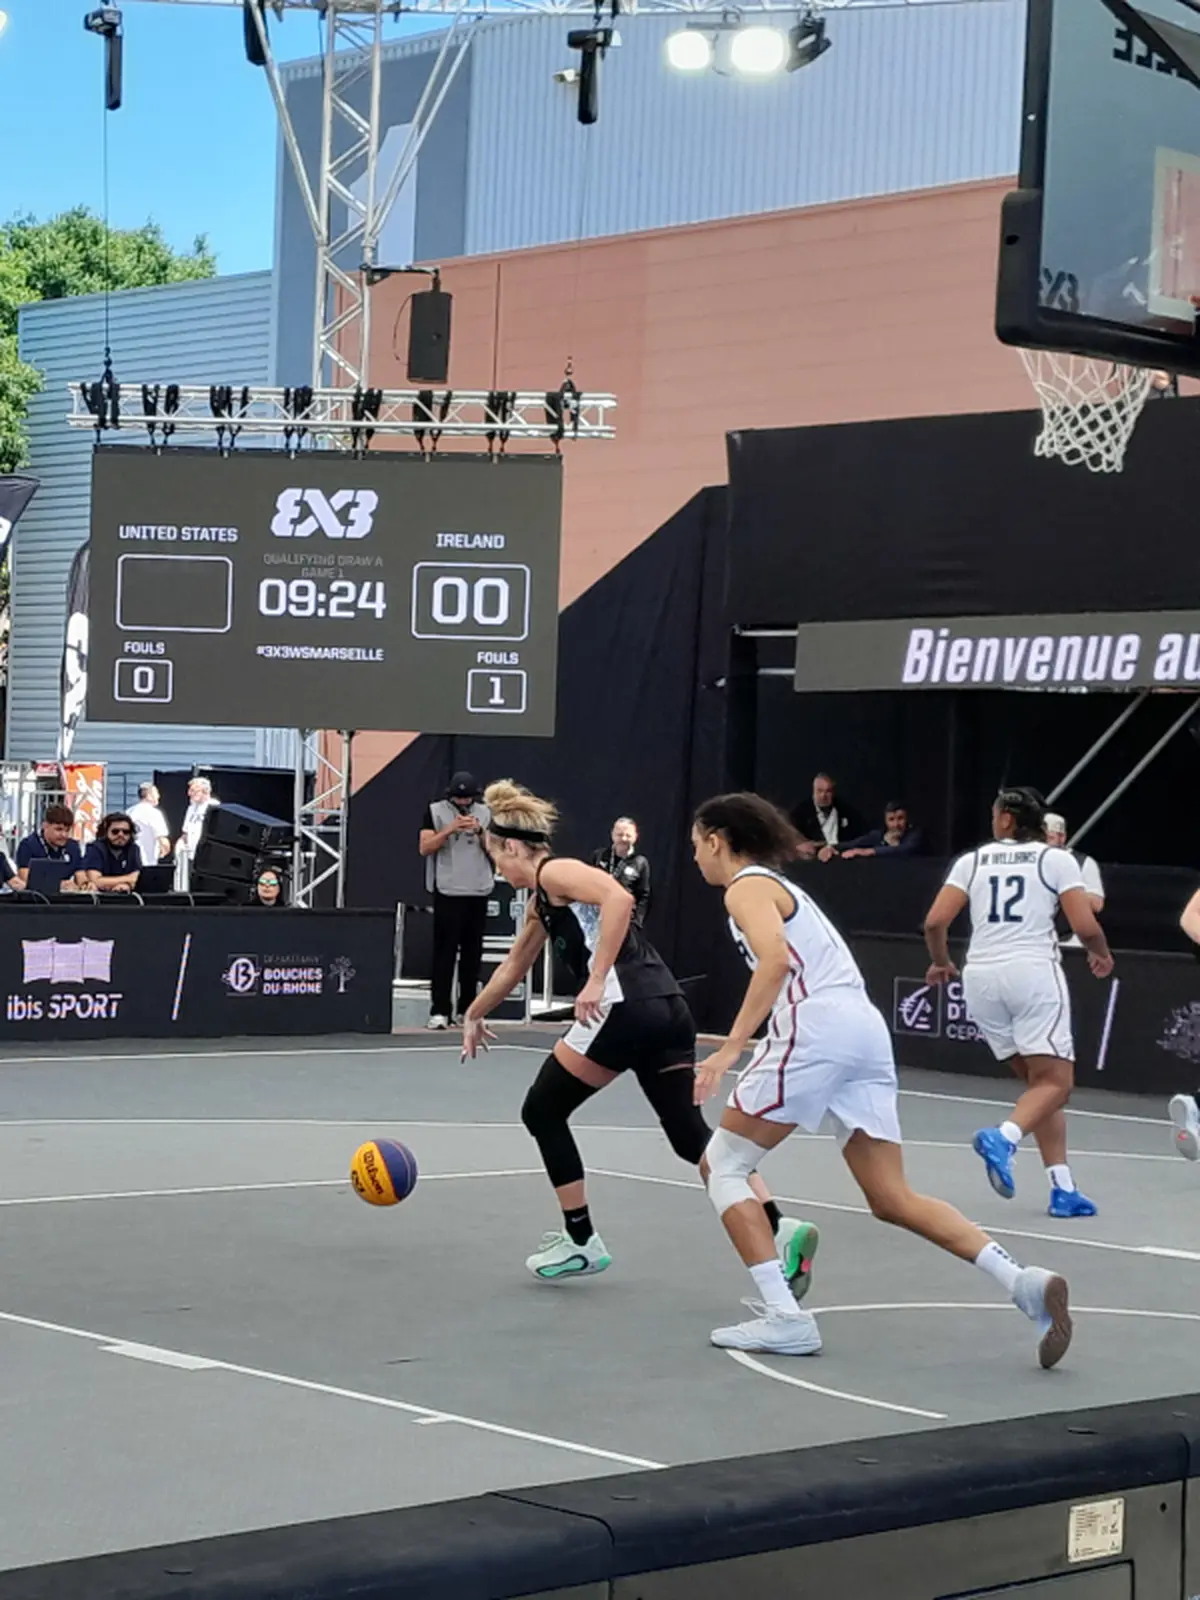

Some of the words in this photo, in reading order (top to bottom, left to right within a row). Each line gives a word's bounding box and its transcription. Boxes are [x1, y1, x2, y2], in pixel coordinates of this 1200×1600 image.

[119, 525, 178, 540] UNITED
[181, 527, 238, 542] STATES
[436, 533, 505, 549] IRELAND
[263, 553, 335, 567] QUALIFYING
[338, 555, 372, 567] DRAW
[301, 567, 336, 579] GAME
[259, 578, 387, 619] 09:24
[431, 576, 510, 625] 00
[124, 641, 165, 655] FOULS
[902, 627, 1141, 684] Bienvenue
[1153, 633, 1200, 682] au
[477, 651, 519, 665] FOULS
[133, 666, 155, 694] 0
[488, 676, 505, 705] 1
[988, 875, 1025, 924] 12
[263, 968, 323, 981] BOUCHES
[263, 982, 280, 995] DU
[7, 995, 43, 1020] ibis
[47, 993, 123, 1019] SPORT
